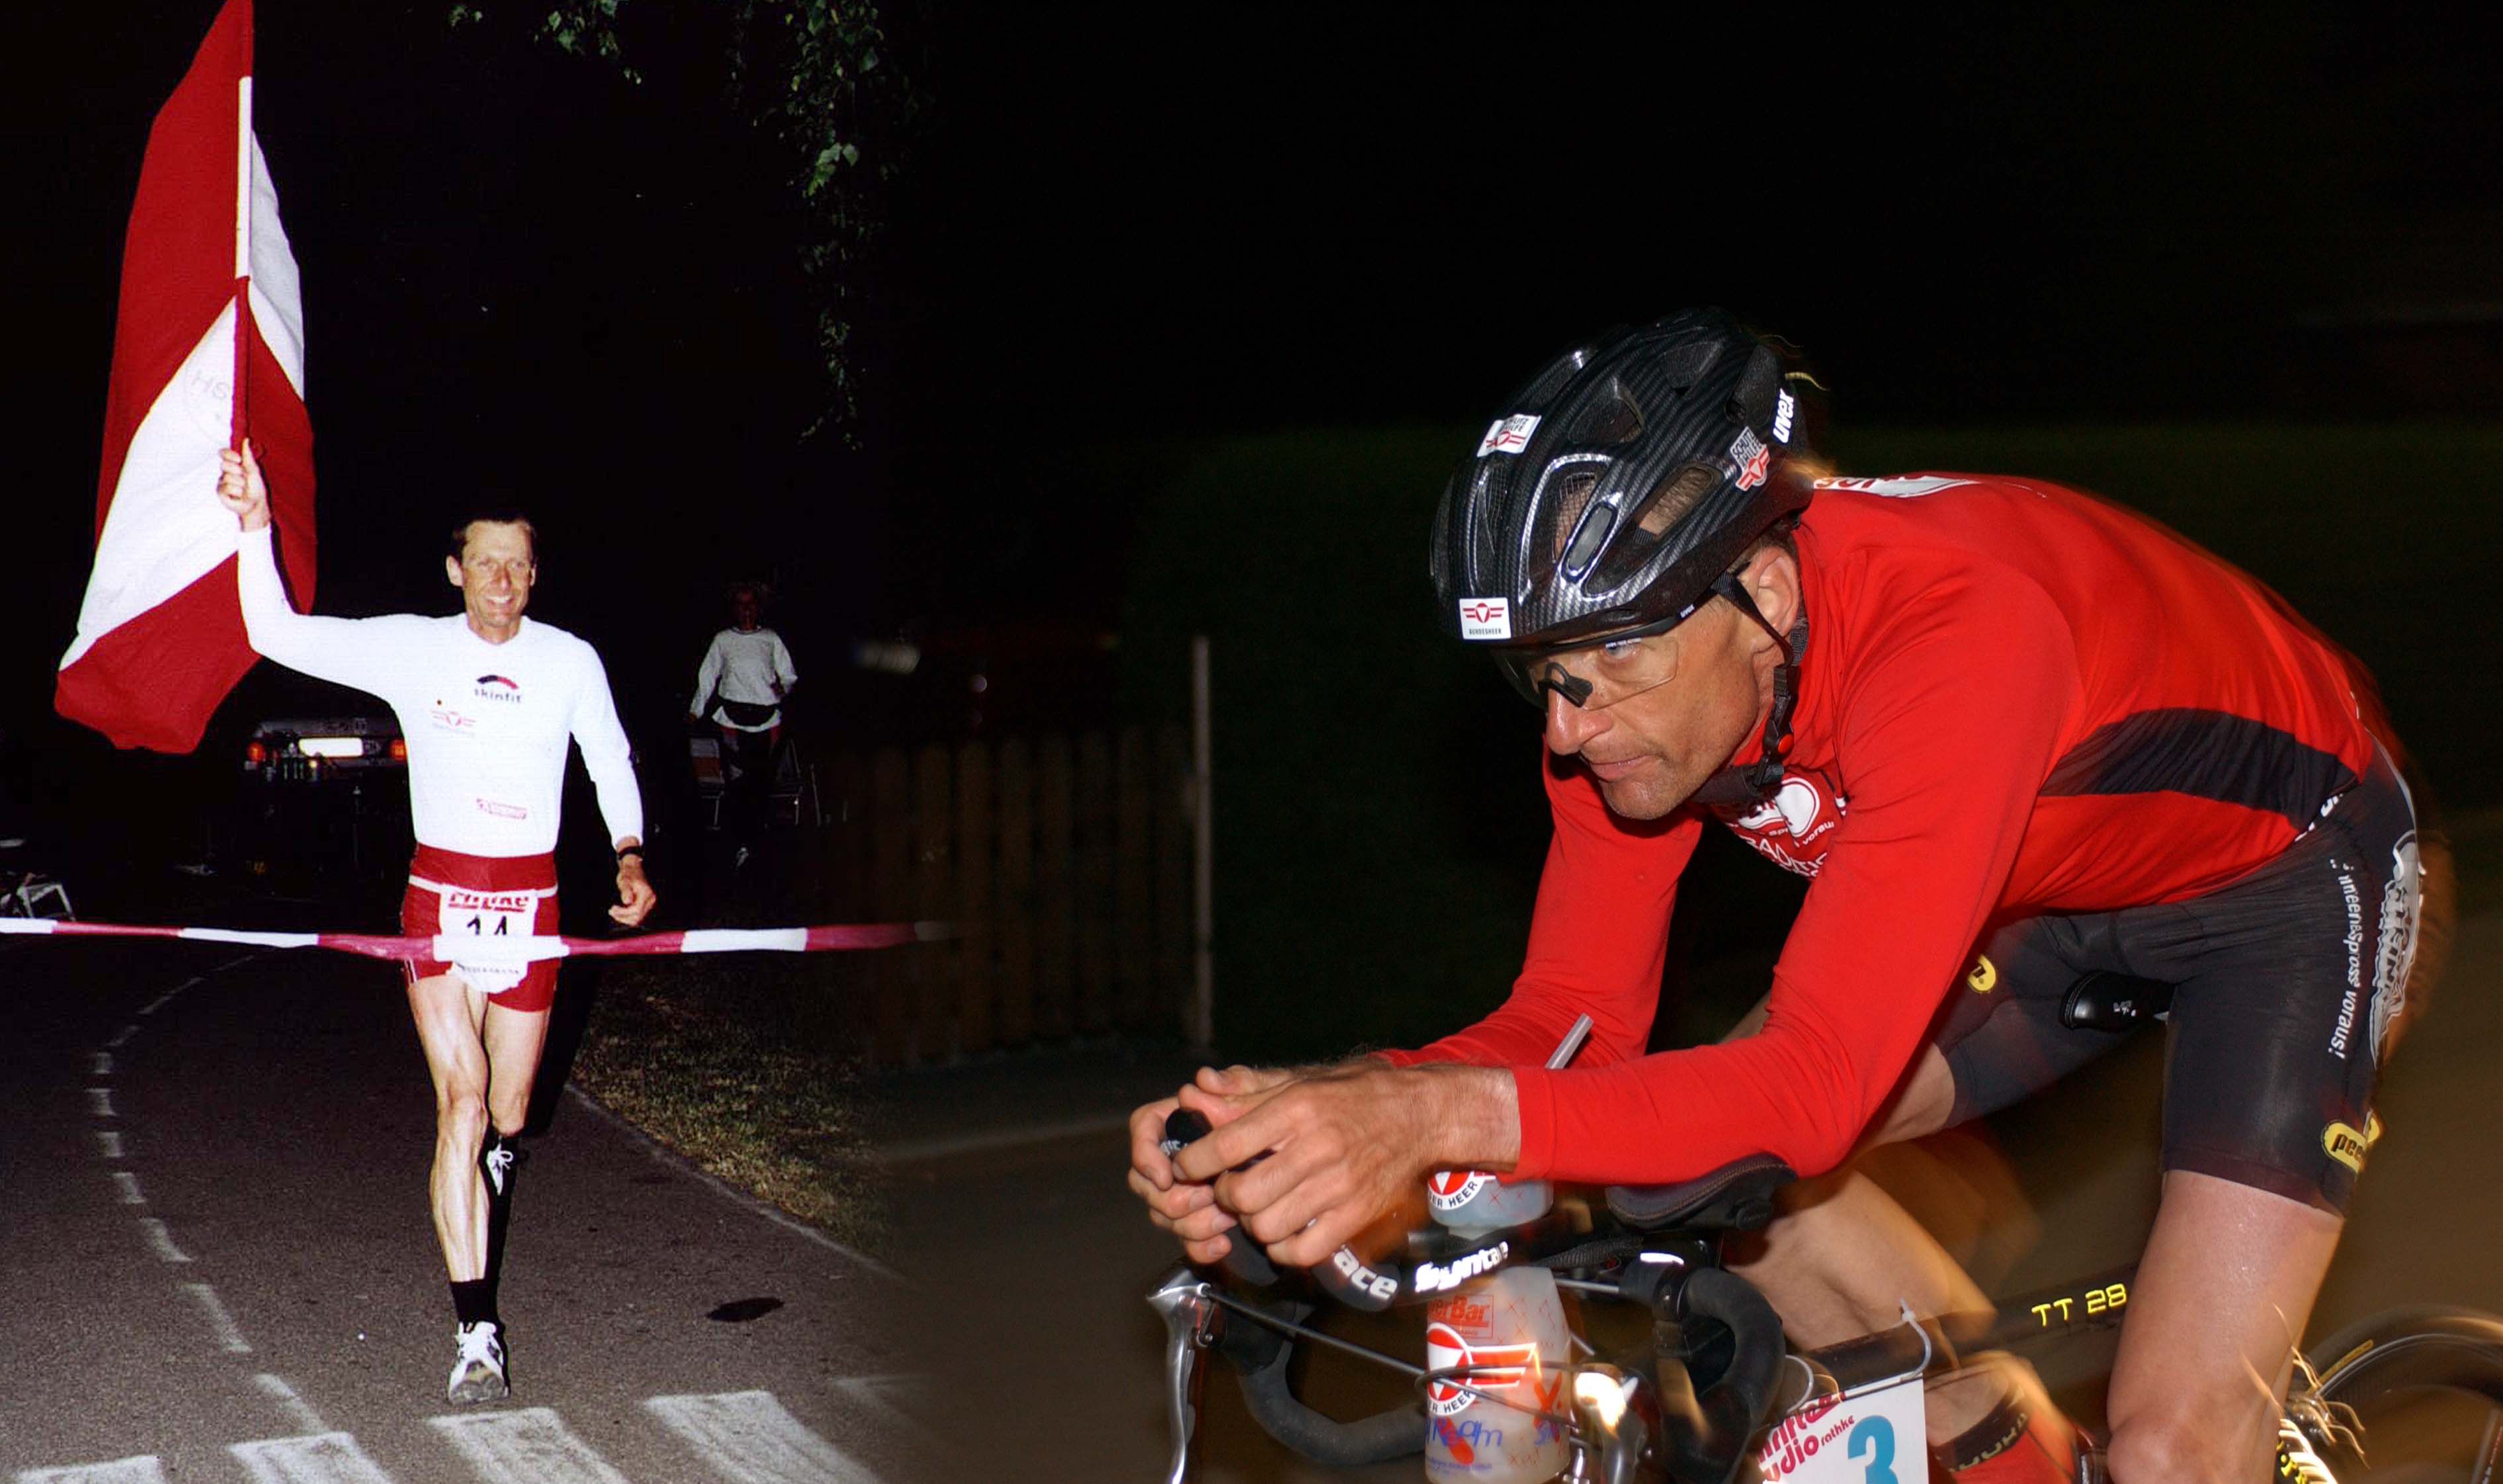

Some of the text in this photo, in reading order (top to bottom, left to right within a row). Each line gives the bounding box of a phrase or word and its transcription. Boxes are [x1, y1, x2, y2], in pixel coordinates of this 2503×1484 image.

[1773, 388, 1794, 443] uvex
[474, 688, 522, 704] skinfit
[2328, 990, 2357, 1059] voraus!
[1448, 1180, 1478, 1207] HEER
[2031, 1283, 2127, 1327] TT 28
[1821, 1415, 1855, 1446] rathke
